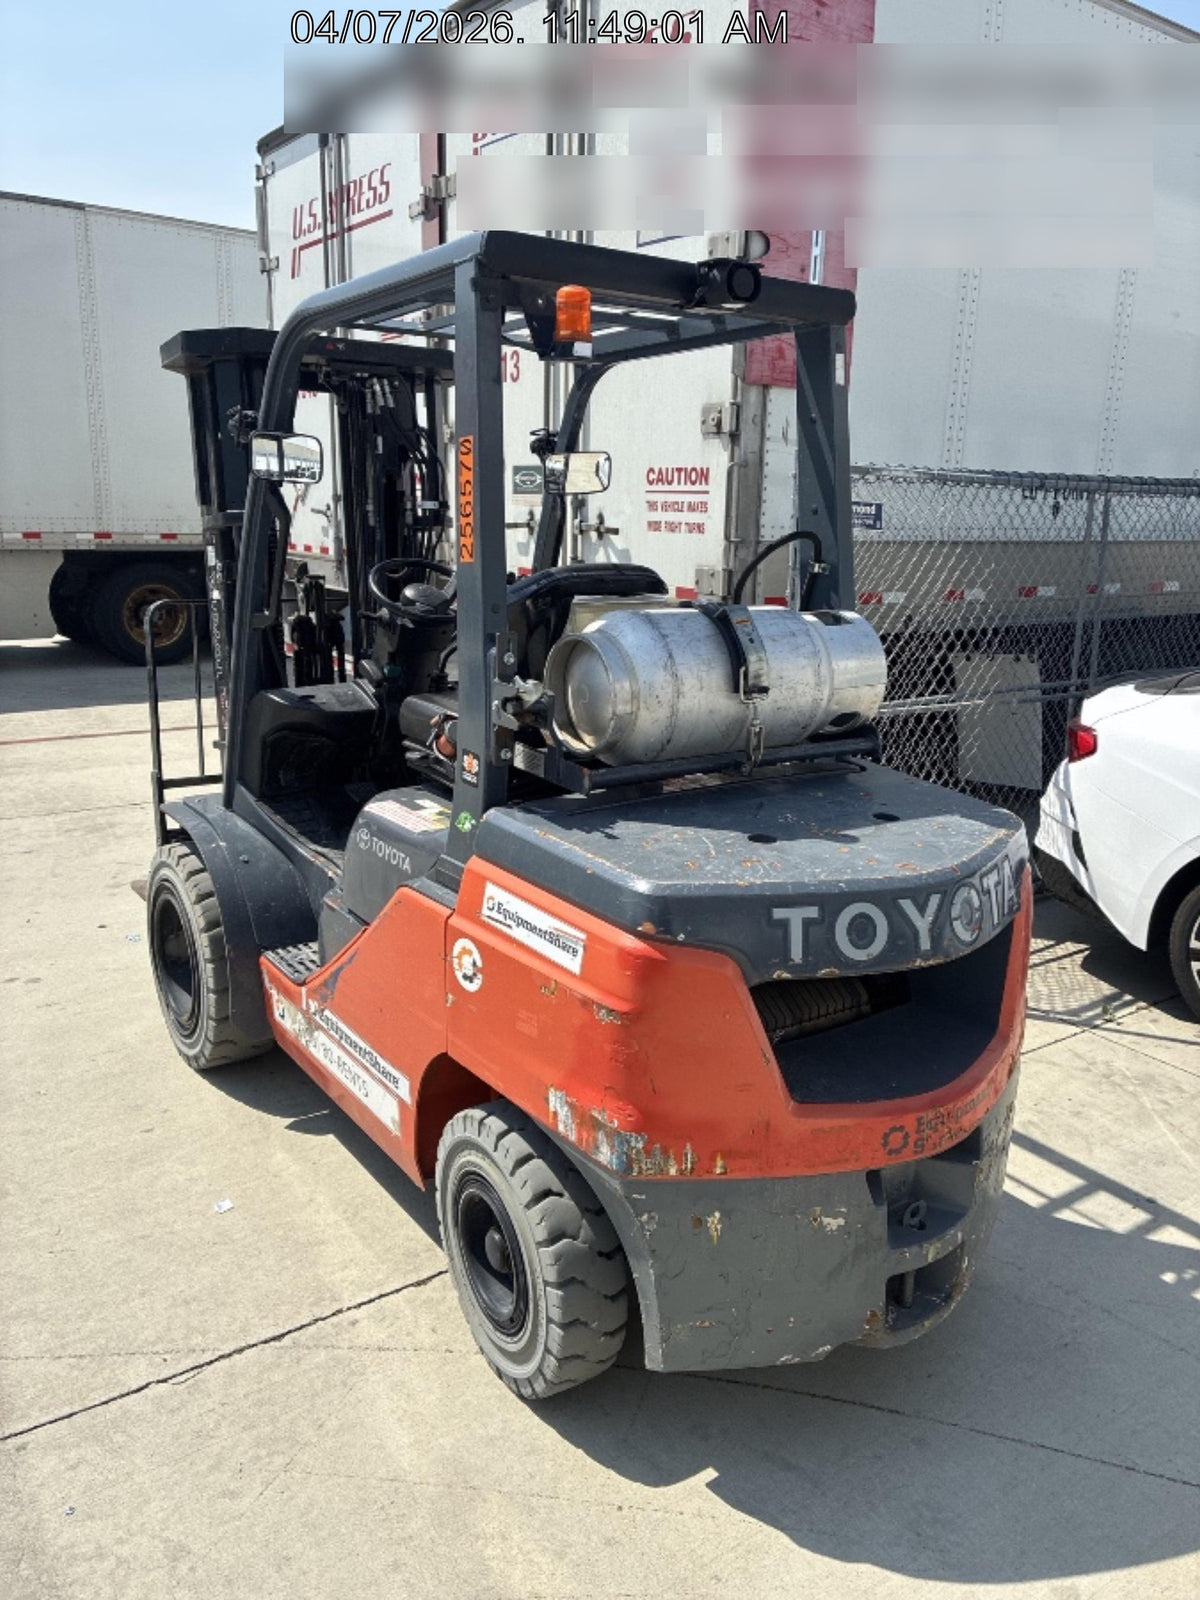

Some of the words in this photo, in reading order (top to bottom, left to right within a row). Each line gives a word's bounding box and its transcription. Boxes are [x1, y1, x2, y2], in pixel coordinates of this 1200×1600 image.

[293, 196, 322, 240] U.S.
[646, 466, 710, 486] CAUTION
[460, 438, 474, 559] 256570
[661, 500, 685, 512] VEHICLE
[372, 837, 412, 874] TOYOTA
[496, 900, 579, 958] EquipmentShare
[772, 855, 1020, 965] TOYOTA
